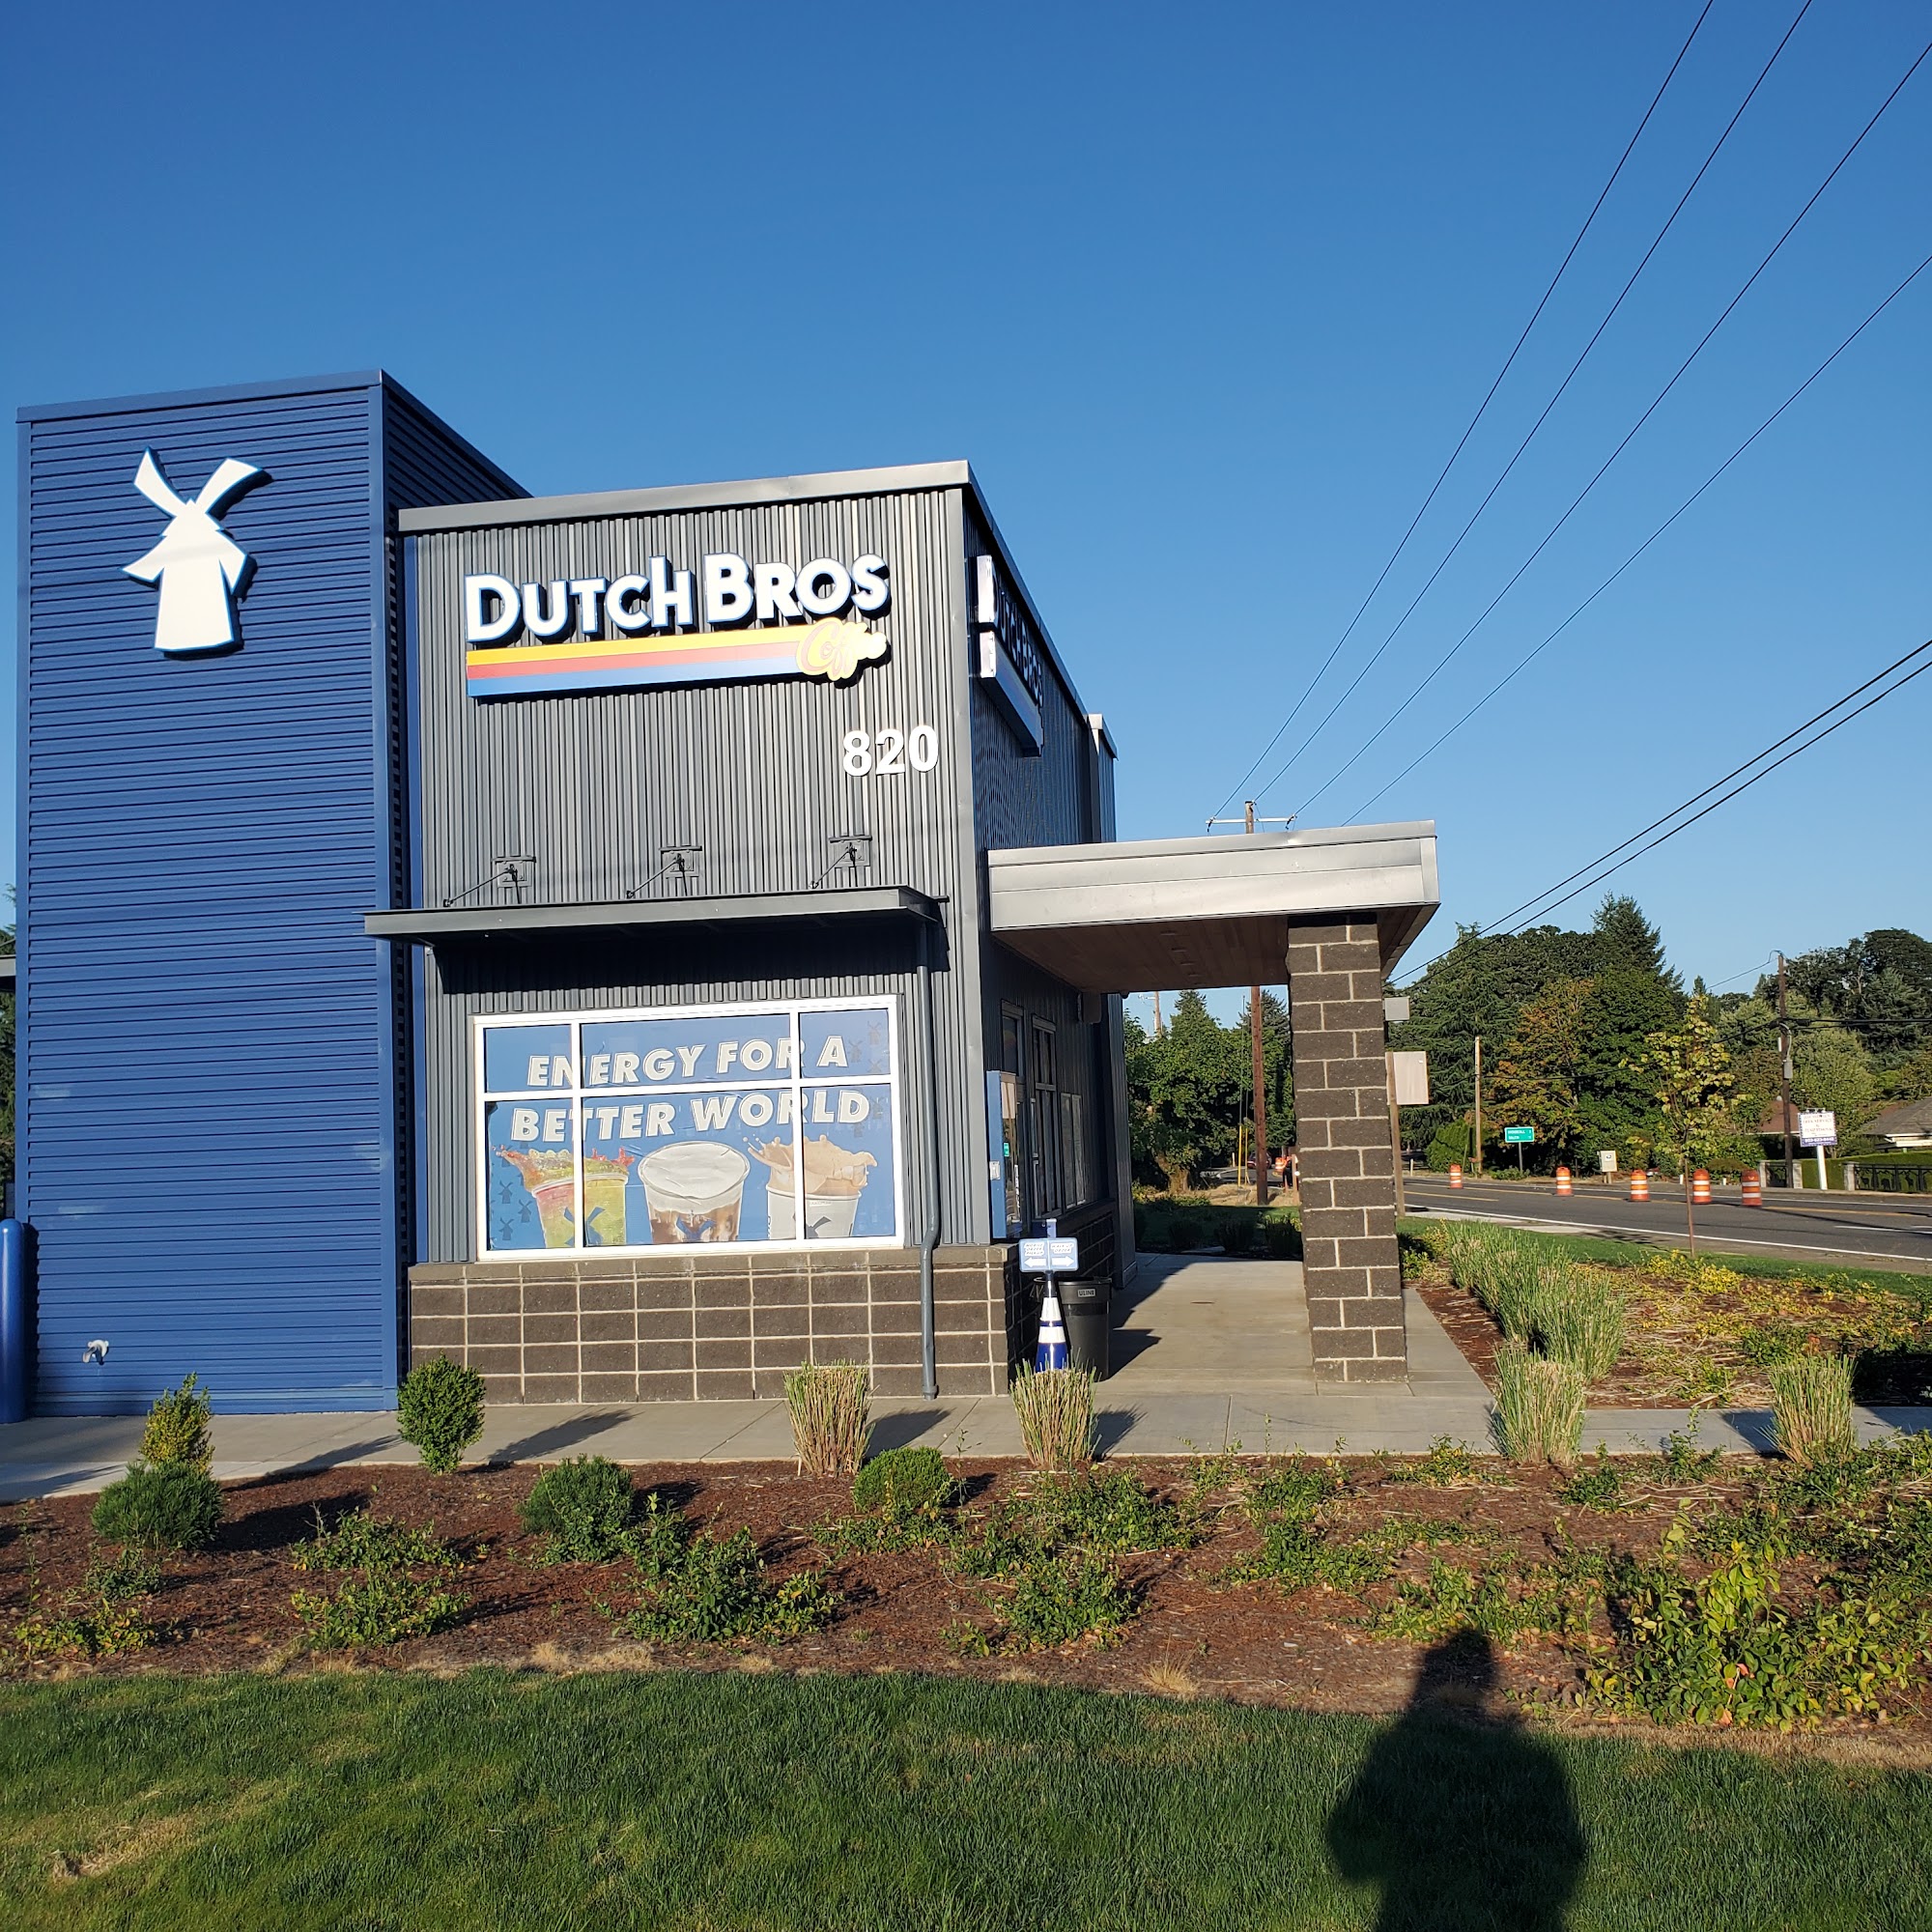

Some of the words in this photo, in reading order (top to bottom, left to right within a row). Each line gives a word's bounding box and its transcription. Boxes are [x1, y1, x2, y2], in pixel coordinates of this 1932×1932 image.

[704, 553, 890, 623] BROS
[842, 724, 939, 777] 820
[527, 1044, 706, 1088] ENERGY
[717, 1037, 806, 1074] FOR
[816, 1036, 848, 1067] A
[690, 1090, 870, 1132] WORLD
